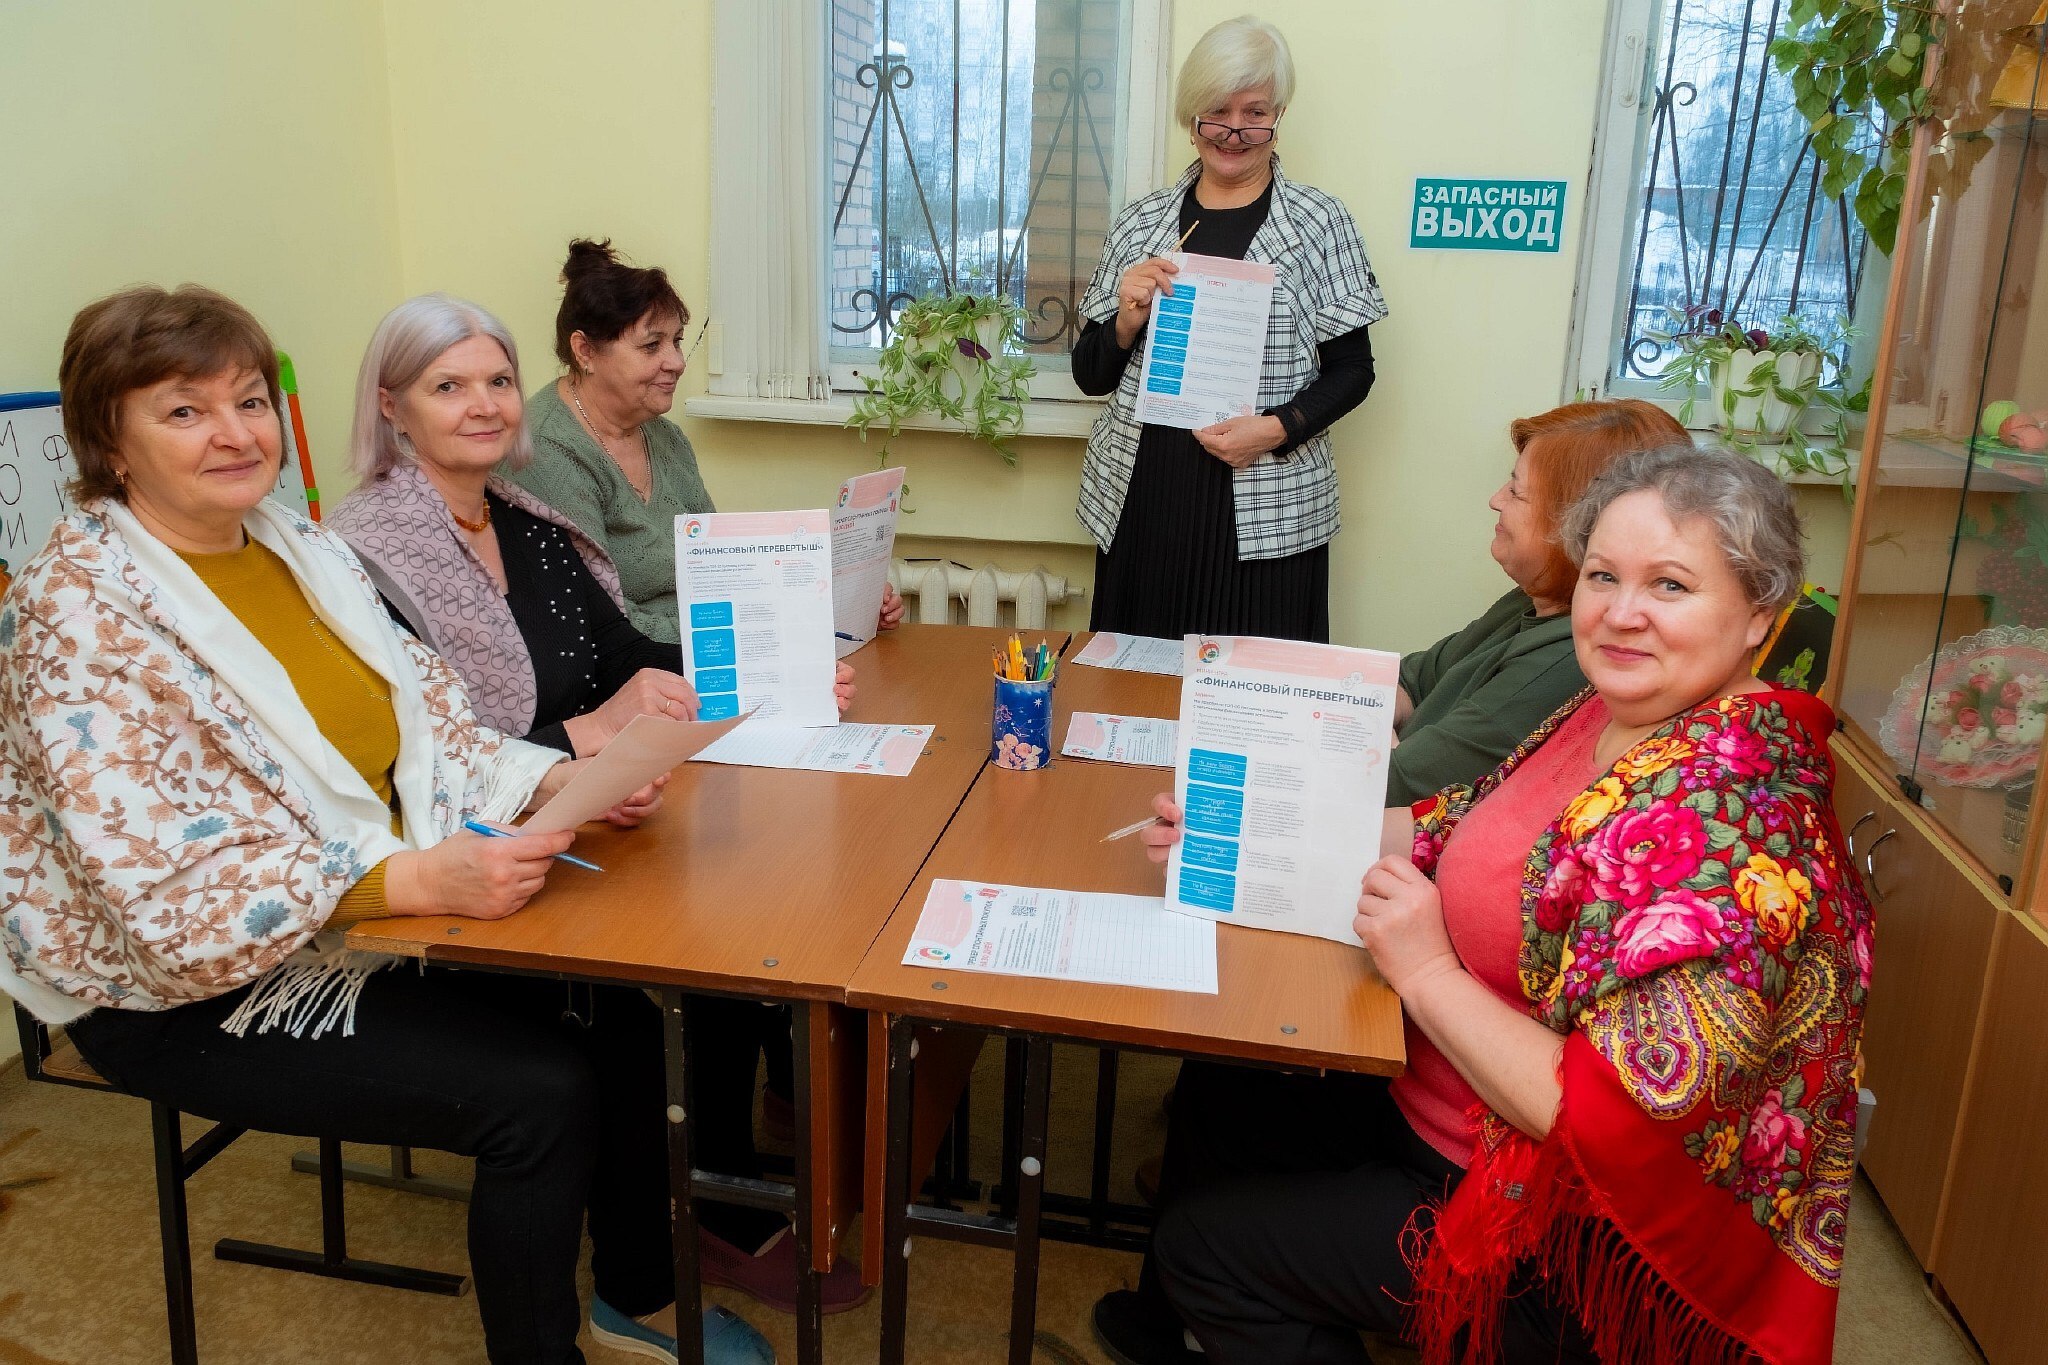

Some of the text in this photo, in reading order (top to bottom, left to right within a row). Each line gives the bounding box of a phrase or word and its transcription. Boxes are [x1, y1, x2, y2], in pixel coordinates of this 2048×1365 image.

[1420, 184, 1558, 206] ЗАПАСНЫЙ
[1415, 206, 1556, 247] ВЫХОД
[686, 543, 824, 555] «ФИНАНСОВЫЙ ПЕРЕВЕРТЫШ»
[1195, 676, 1385, 709] «ФИНАНСОВЫЙ ПЕРЕВЕРТЫШ»
